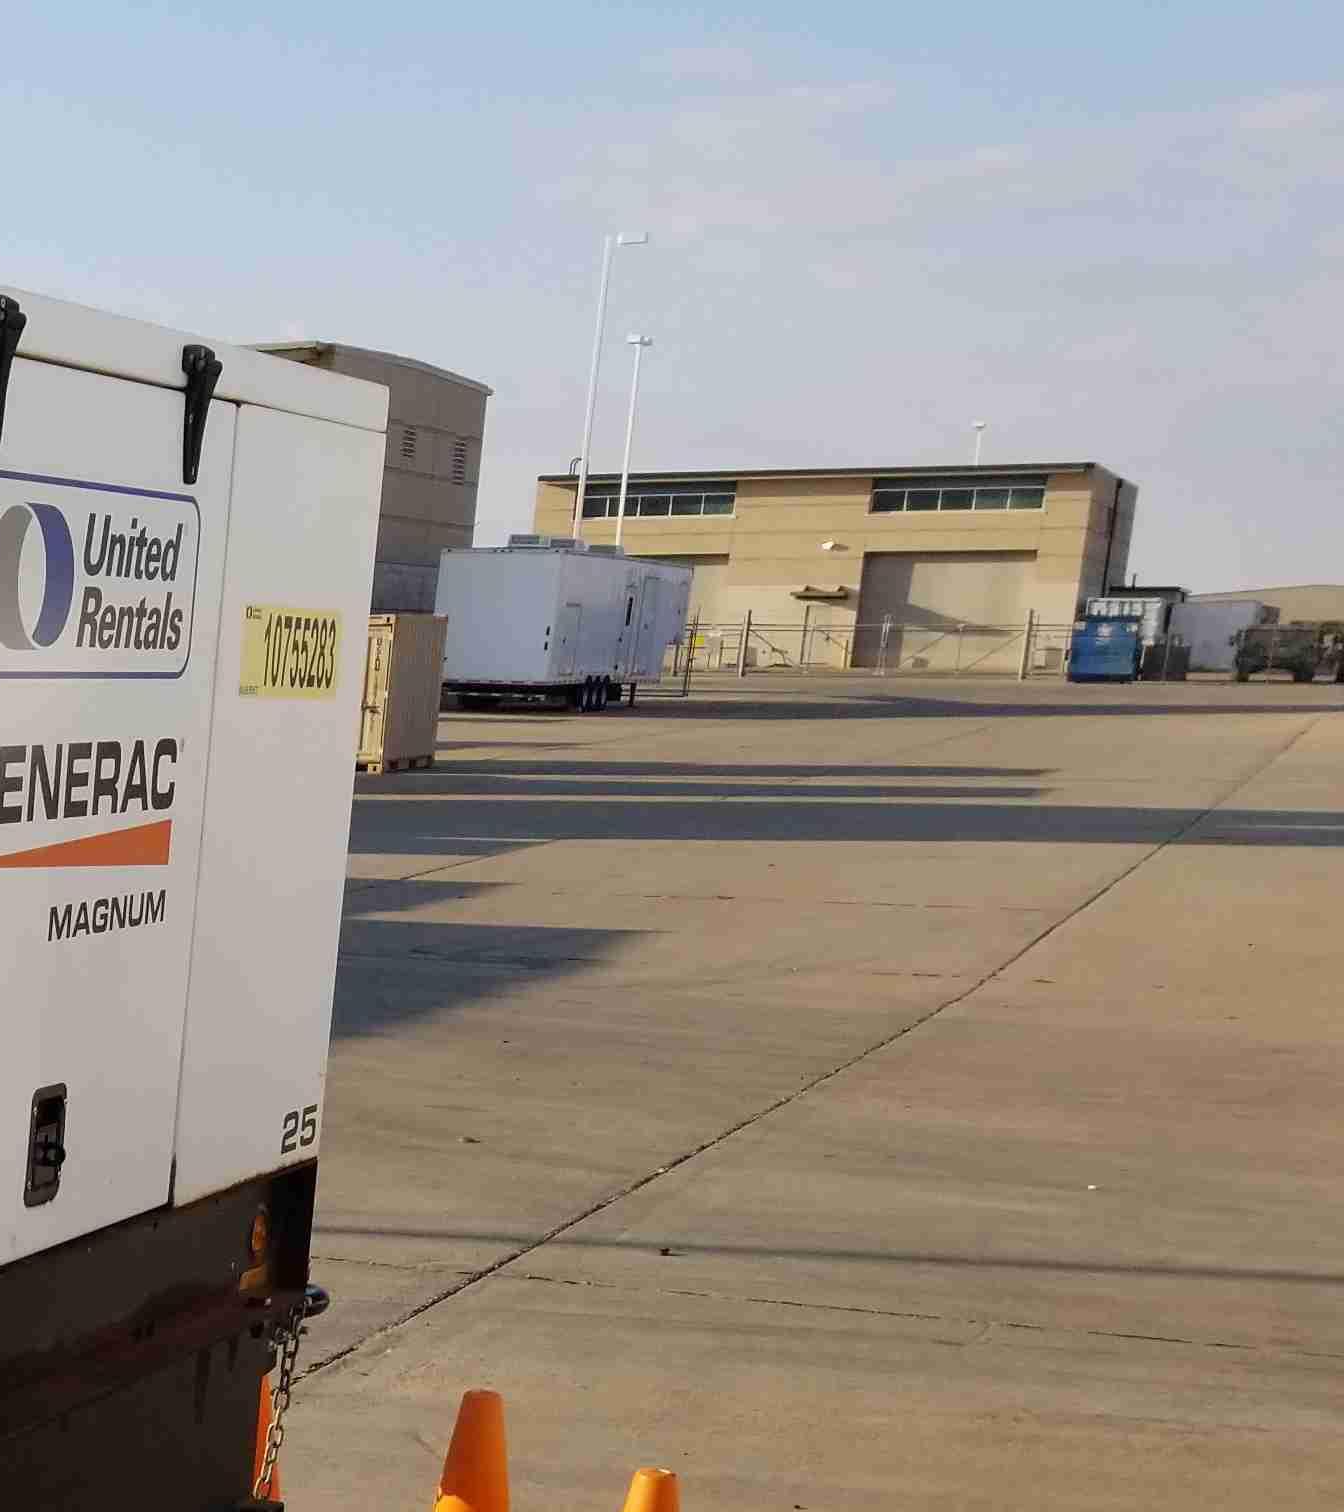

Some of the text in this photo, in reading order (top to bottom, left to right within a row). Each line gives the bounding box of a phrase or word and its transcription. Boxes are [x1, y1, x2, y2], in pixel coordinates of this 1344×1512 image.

[83, 512, 184, 581] United
[75, 586, 184, 650] Rentals
[264, 613, 336, 688] 10755283
[47, 889, 167, 942] MAGNUM
[280, 1103, 318, 1155] 25
